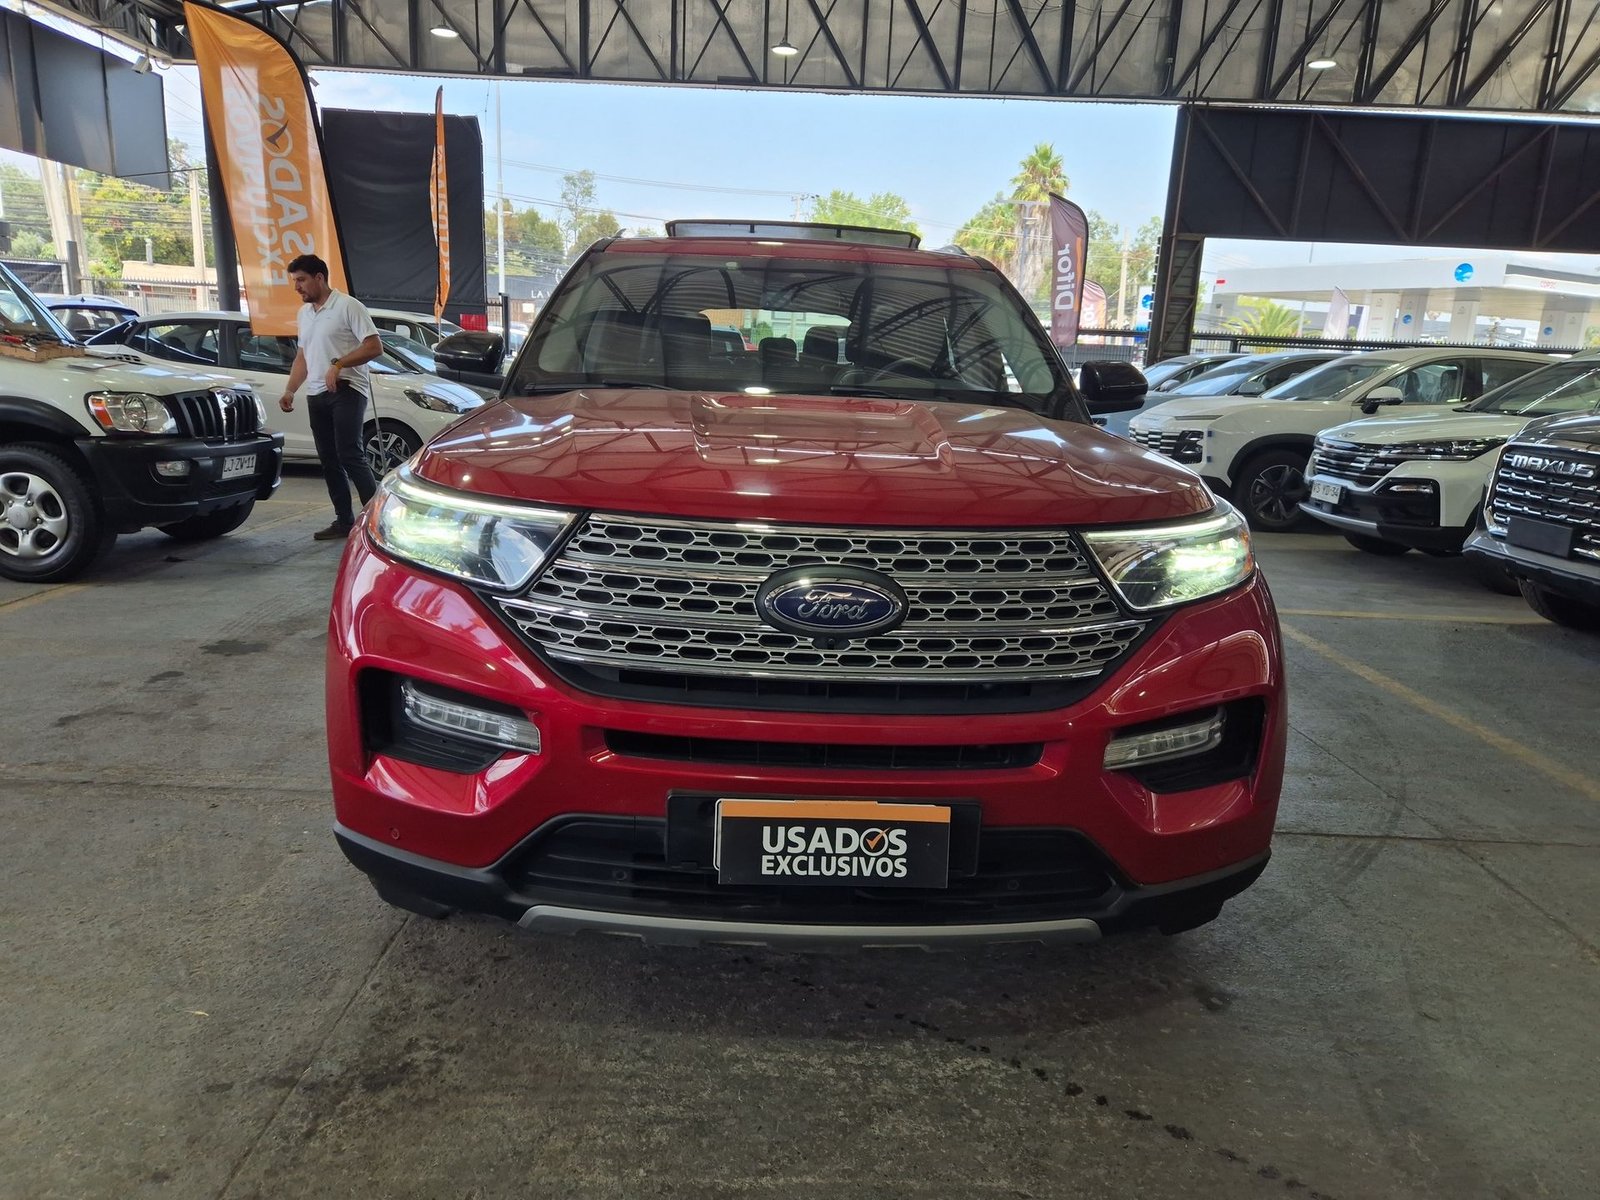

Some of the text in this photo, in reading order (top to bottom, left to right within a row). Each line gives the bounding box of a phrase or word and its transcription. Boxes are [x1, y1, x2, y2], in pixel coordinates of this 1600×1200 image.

[1510, 454, 1597, 478] MAXUS
[798, 589, 868, 620] Ford
[762, 825, 908, 857] USADOS
[761, 855, 908, 878] EXCLUSIVOS
